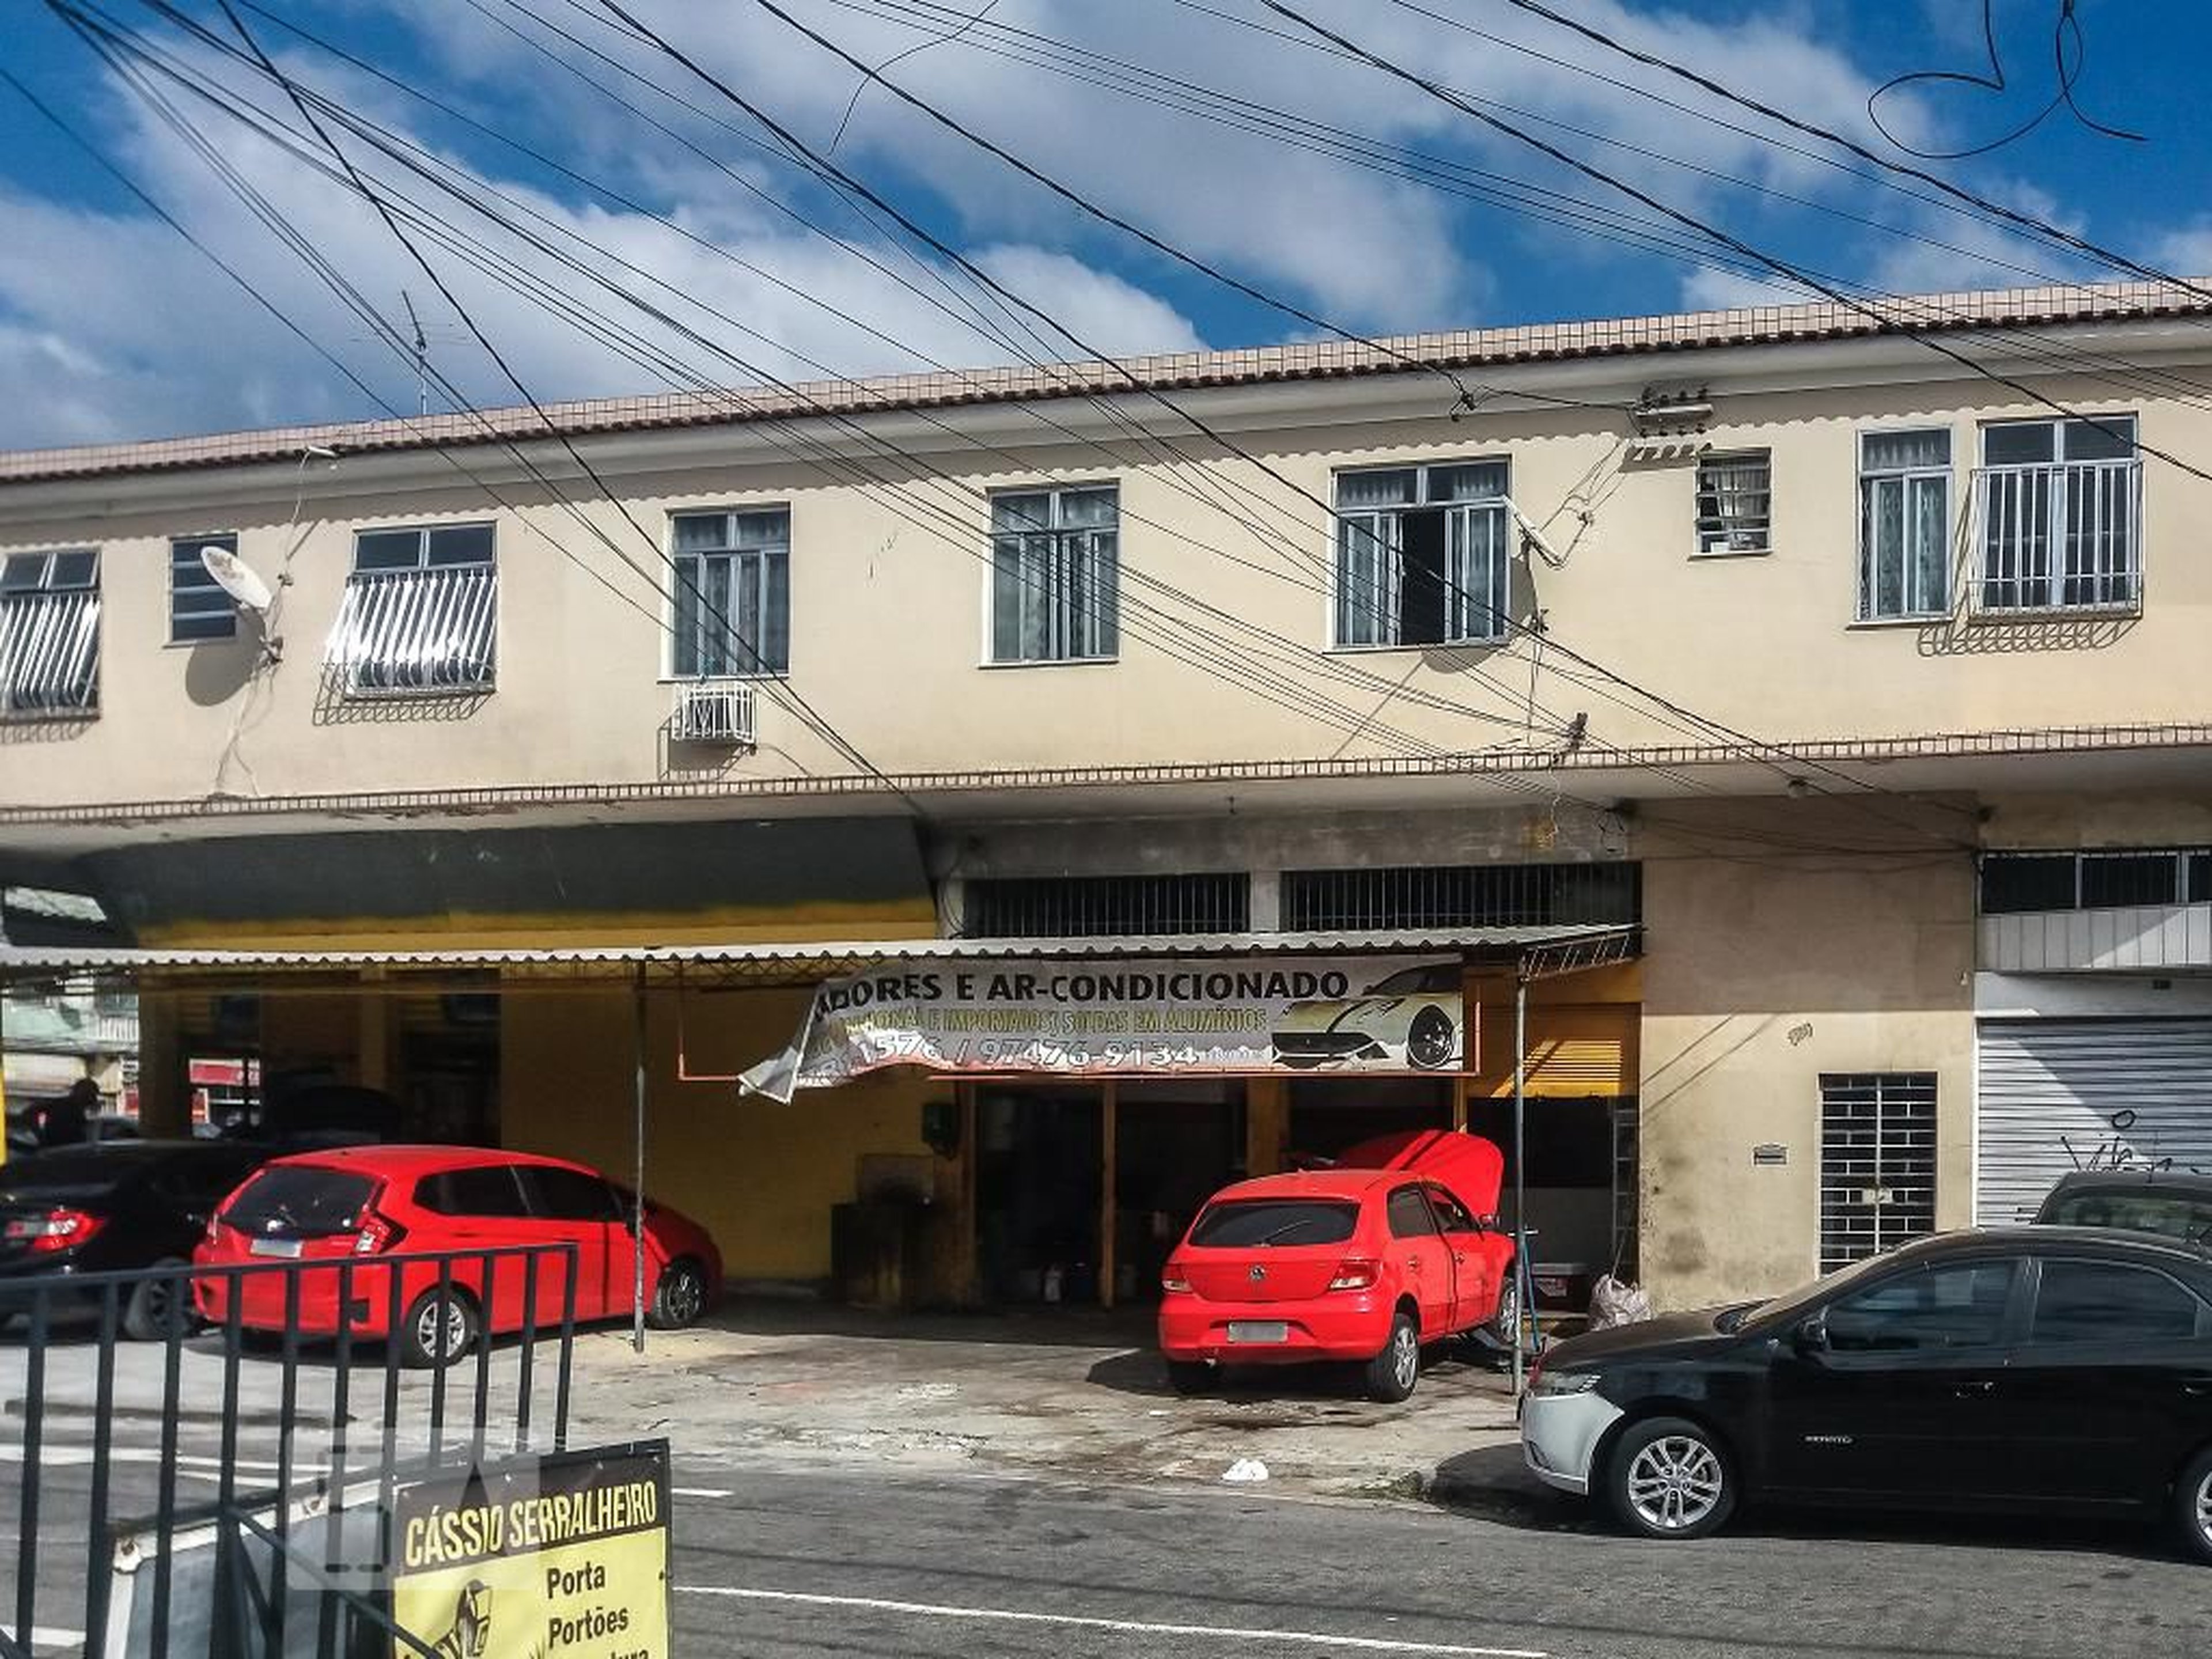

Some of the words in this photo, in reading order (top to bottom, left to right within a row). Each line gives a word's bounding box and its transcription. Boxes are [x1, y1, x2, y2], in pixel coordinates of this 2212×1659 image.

[957, 974, 975, 1001] E
[986, 971, 1349, 1003] AR-CONDICIONADO
[980, 1038, 1200, 1067] 97476-9134
[405, 1503, 505, 1567] CÁSSIO
[509, 1480, 657, 1548] SERRALHEIRO
[547, 1560, 605, 1600] Porta
[548, 1605, 629, 1649] Portões
